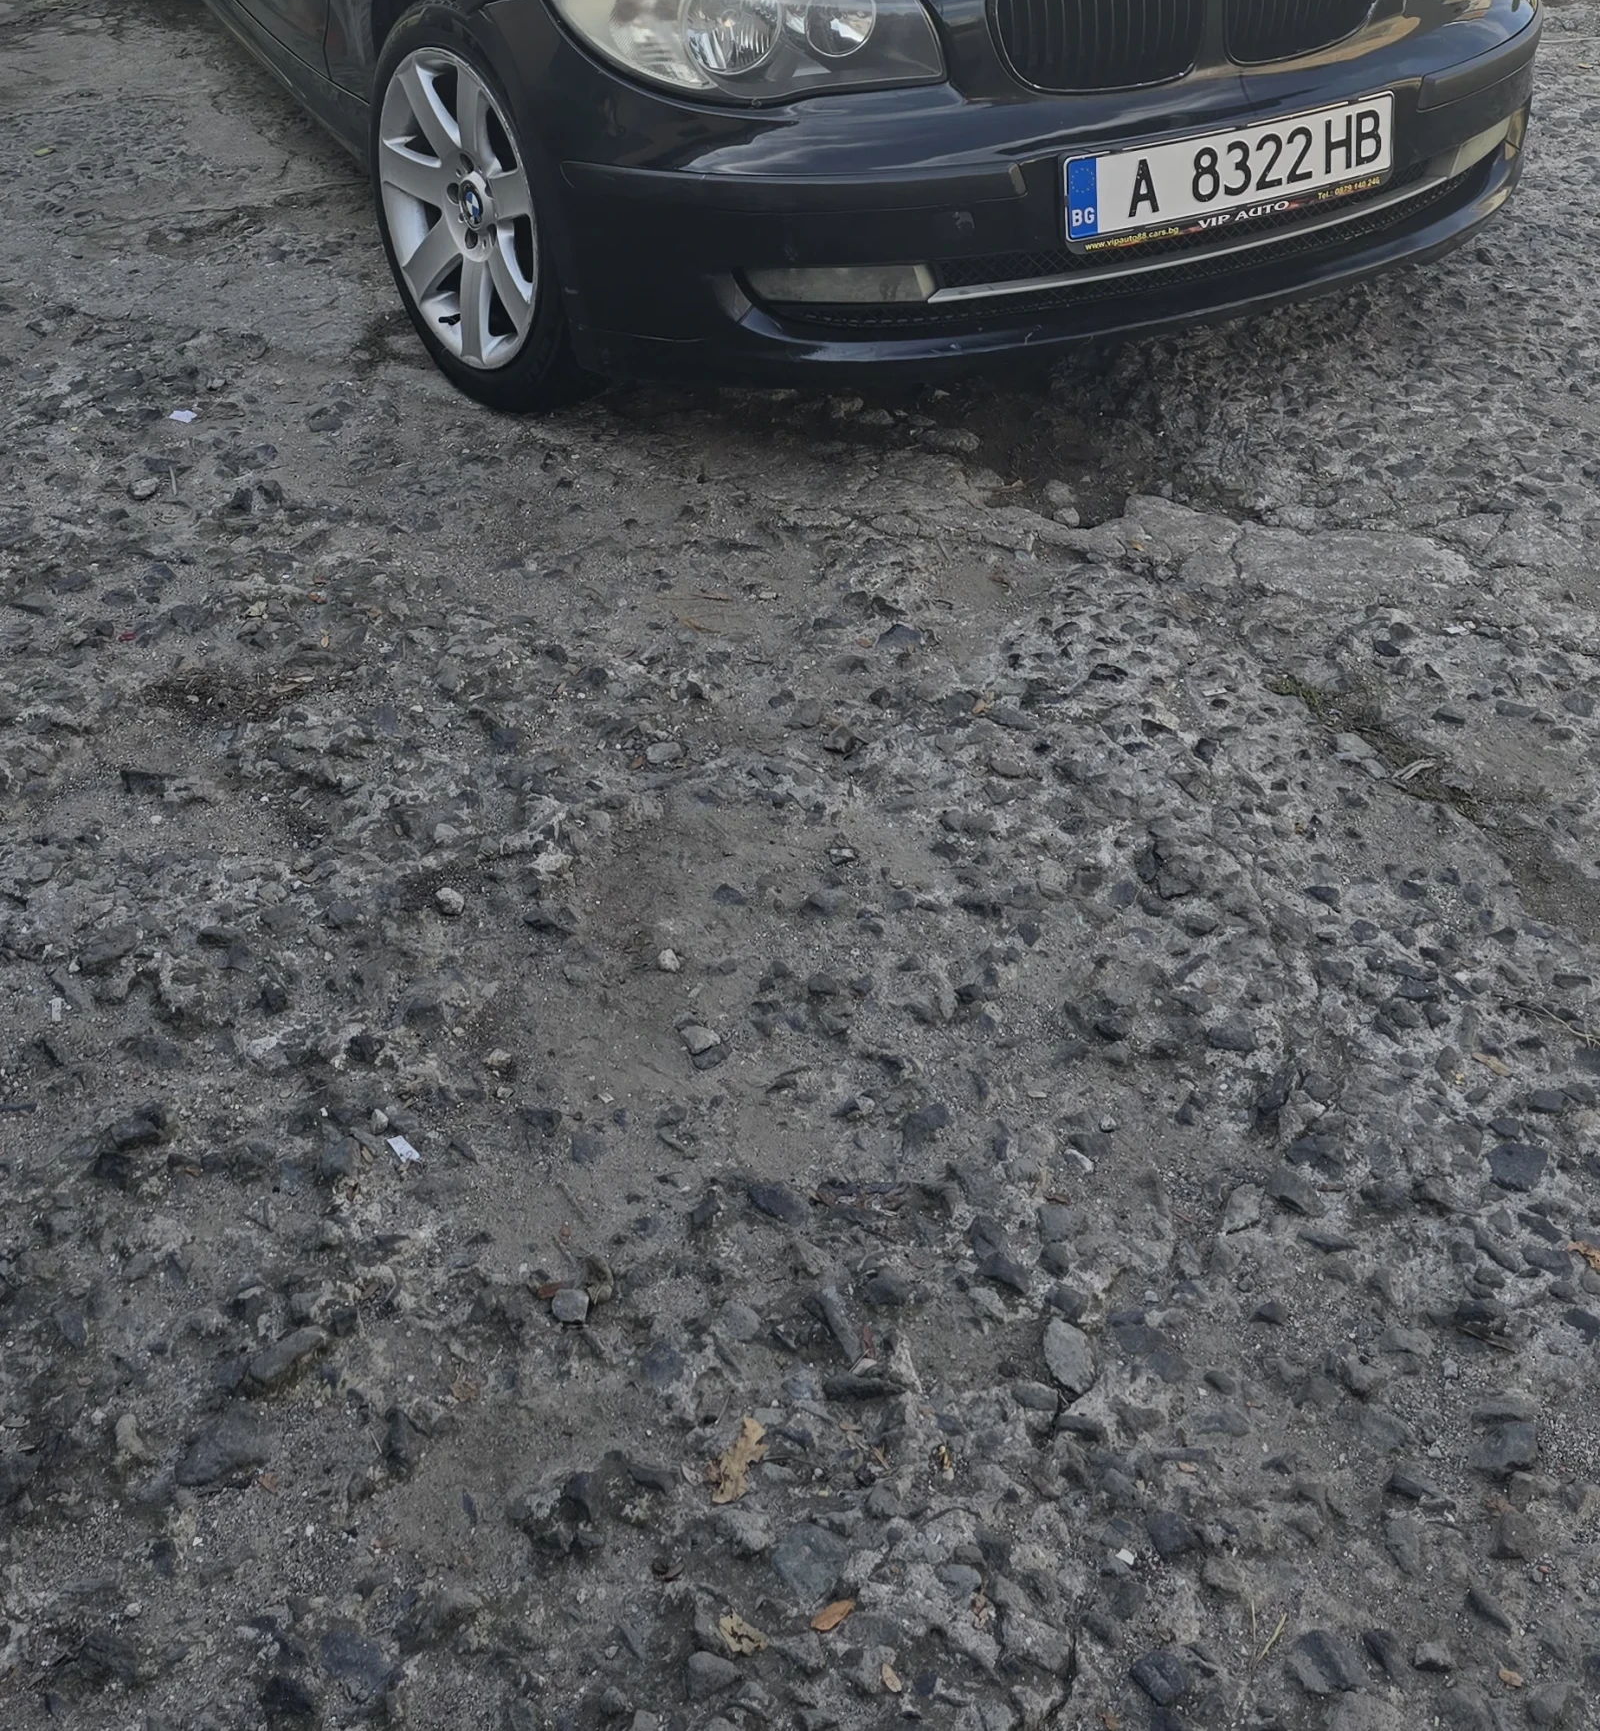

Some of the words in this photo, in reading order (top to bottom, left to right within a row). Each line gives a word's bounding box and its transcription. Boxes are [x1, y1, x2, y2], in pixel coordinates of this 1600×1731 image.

[1128, 158, 1160, 218] A
[1192, 126, 1313, 203] 8322
[1324, 109, 1382, 175] HB
[1072, 207, 1095, 227] BG
[1198, 214, 1231, 229] VIP
[1234, 200, 1290, 222] AUTO
